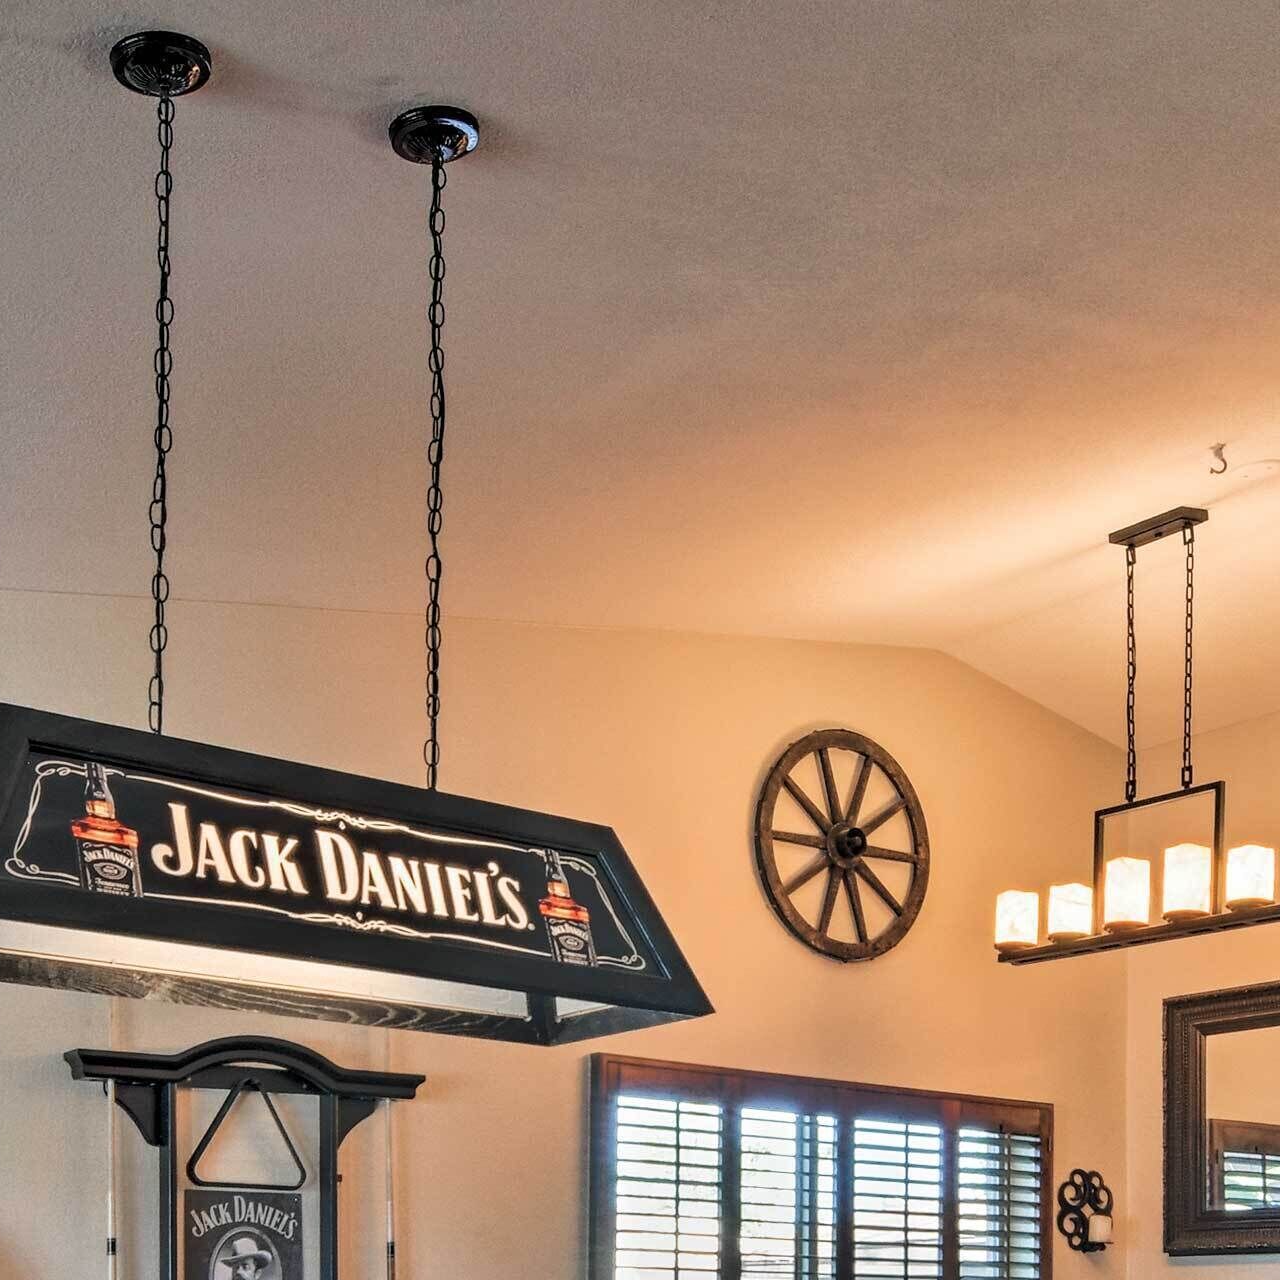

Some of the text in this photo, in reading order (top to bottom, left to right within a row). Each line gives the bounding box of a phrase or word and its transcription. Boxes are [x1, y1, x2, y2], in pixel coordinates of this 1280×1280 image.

[149, 803, 535, 933] JACK DANIEL'S
[190, 1195, 298, 1240] JACK DANIEL'S
